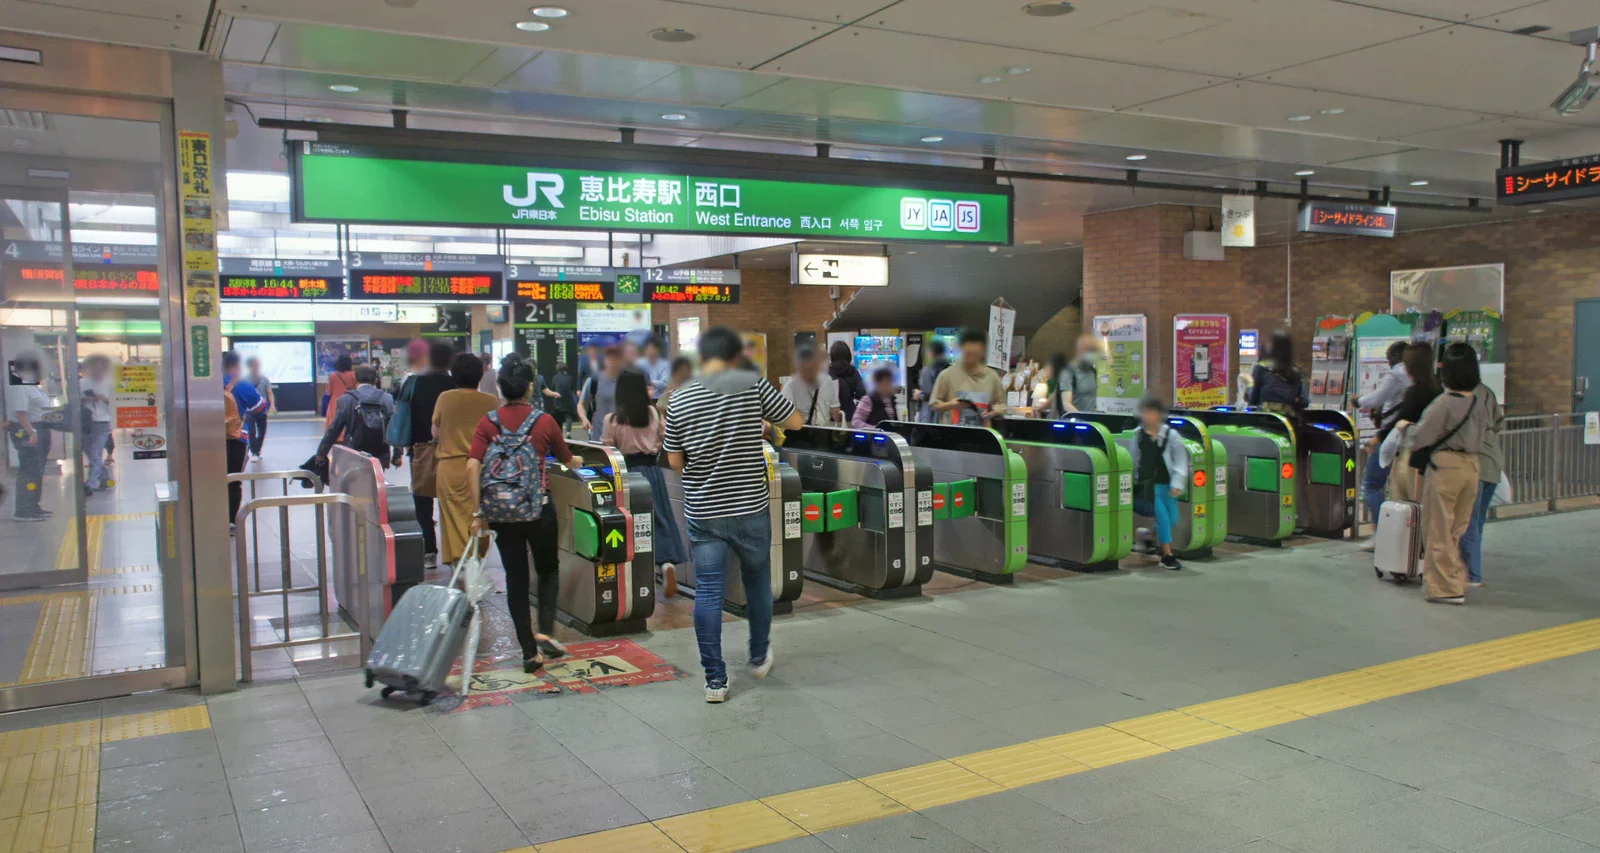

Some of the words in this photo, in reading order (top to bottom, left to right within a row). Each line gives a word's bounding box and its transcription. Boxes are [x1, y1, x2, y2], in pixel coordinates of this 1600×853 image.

[1517, 165, 1600, 192] シーサイドラ
[502, 172, 565, 209] JR
[579, 176, 681, 206] 恵比寿駅
[695, 181, 741, 208] 西口
[511, 209, 557, 221] JR東日本
[580, 207, 621, 222] Ebisu
[625, 209, 674, 224] Station
[906, 207, 920, 221] JY
[934, 208, 948, 222] JA
[961, 210, 973, 223] JS
[1226, 208, 1251, 219] きっぷ
[695, 212, 731, 227] West
[734, 213, 791, 229] Entrance
[801, 217, 832, 230] 西入口
[840, 219, 860, 232] 서쪽
[863, 220, 884, 232] 입구
[4, 242, 20, 258] 4
[352, 253, 362, 267] 3
[101, 271, 136, 281] 16:52
[509, 265, 518, 278] 3
[263, 279, 295, 288] 16:44
[423, 277, 449, 286] 17:01
[550, 283, 574, 292] 16:53
[423, 285, 450, 294] 17:30
[550, 291, 574, 300] 16:58
[574, 291, 604, 300] OMIYA
[655, 285, 679, 294] 16:42
[725, 286, 730, 295] 1
[439, 318, 449, 332] 2
[1189, 443, 1204, 454] IC
[634, 523, 650, 531] 今すぐ
